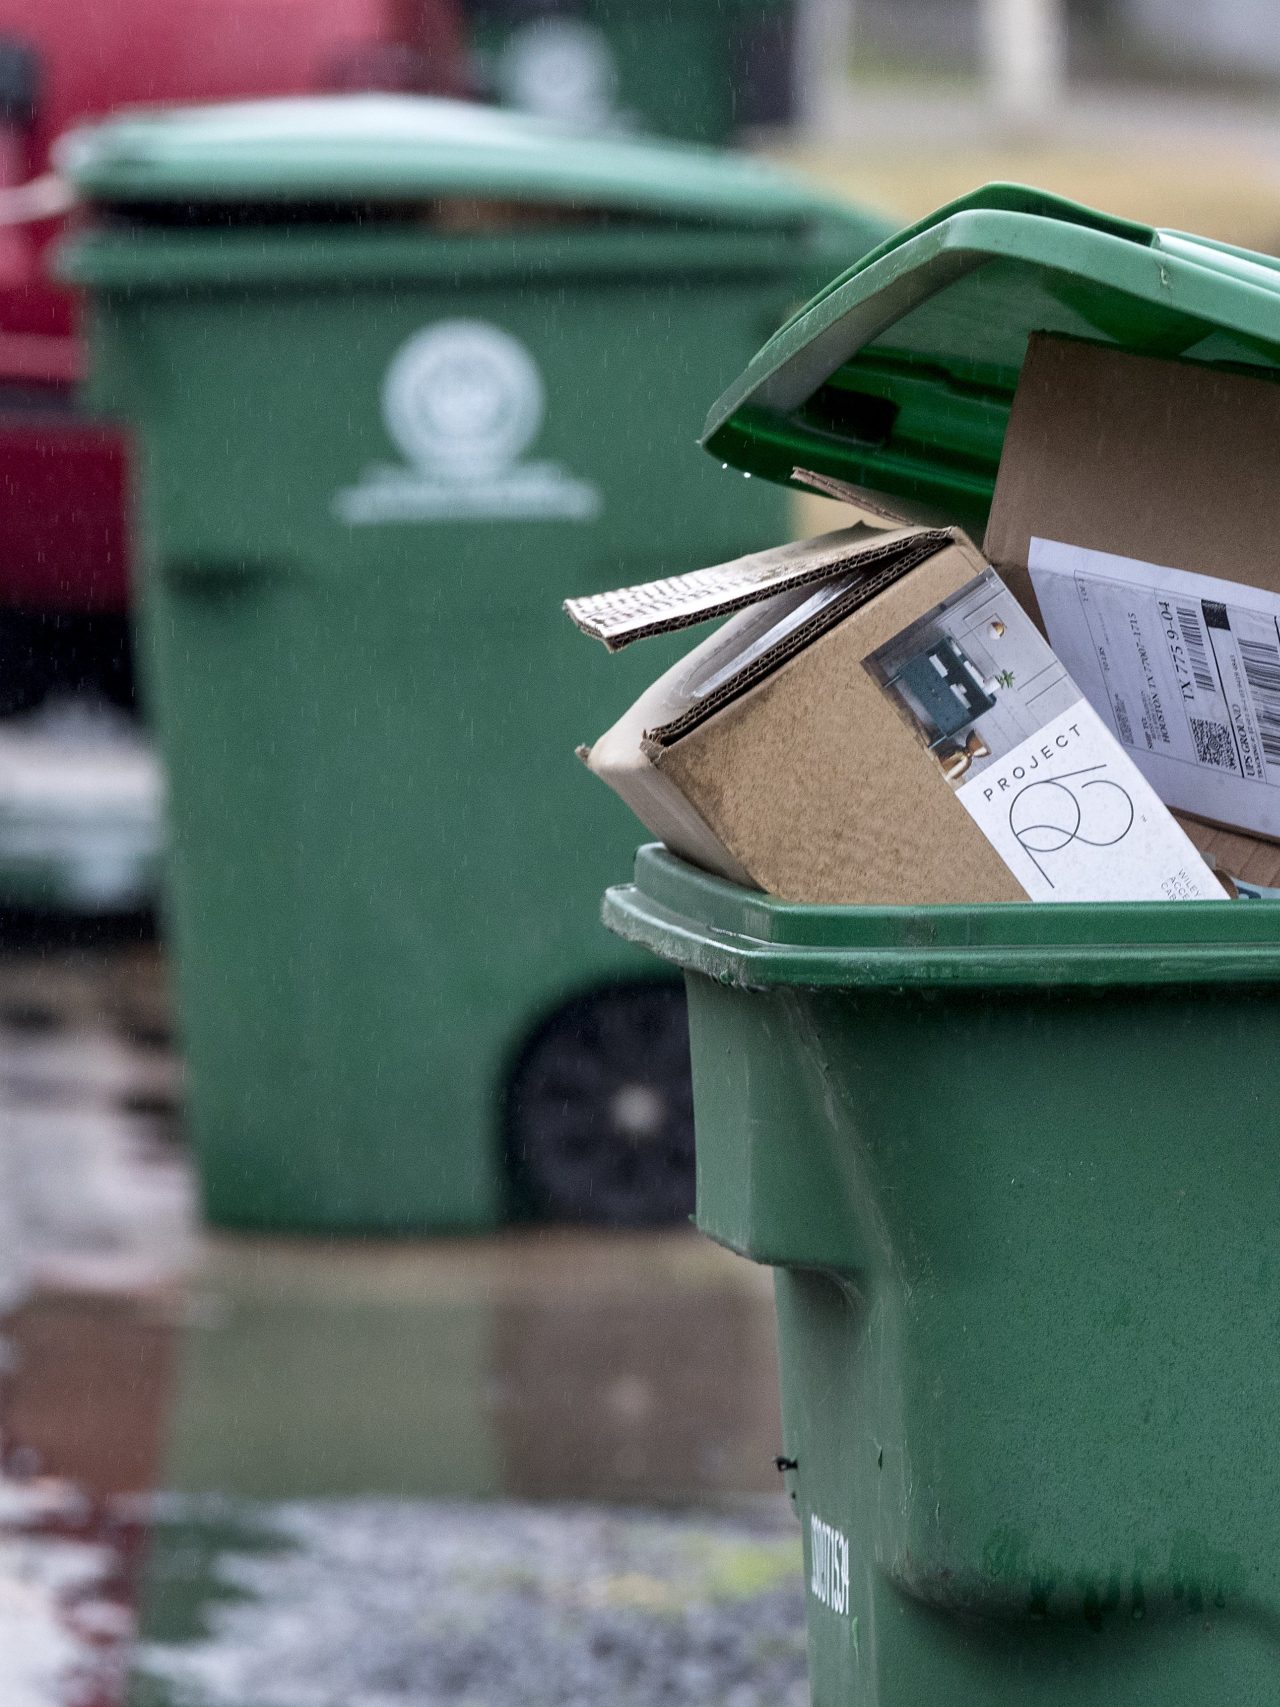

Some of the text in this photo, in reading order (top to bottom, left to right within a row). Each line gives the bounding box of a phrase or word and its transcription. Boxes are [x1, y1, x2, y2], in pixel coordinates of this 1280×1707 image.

[1157, 598, 1196, 703] TX 775 9-04
[1150, 691, 1171, 743] HOUSTON
[1230, 702, 1251, 753] GROUND
[983, 723, 1082, 802] PROJECT
[1242, 753, 1257, 777] UPS
[1178, 867, 1201, 897] WILEY
